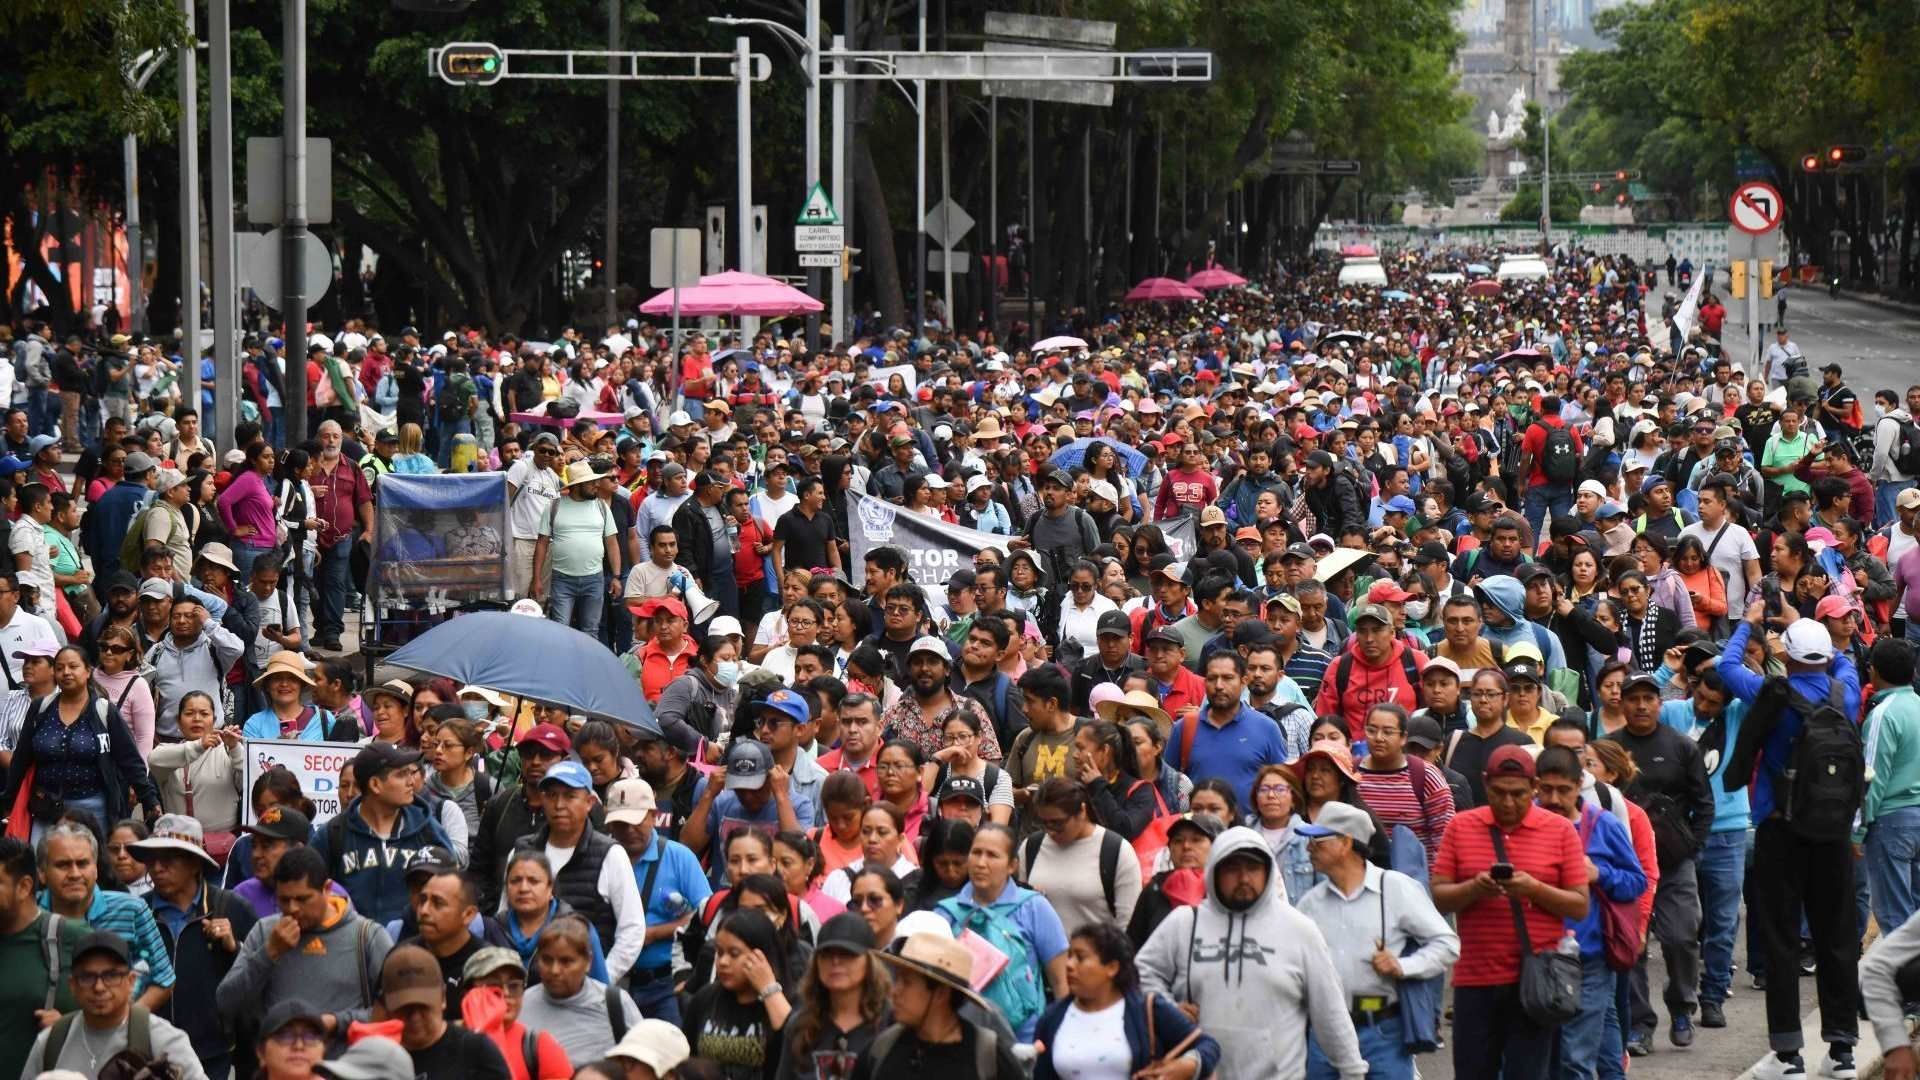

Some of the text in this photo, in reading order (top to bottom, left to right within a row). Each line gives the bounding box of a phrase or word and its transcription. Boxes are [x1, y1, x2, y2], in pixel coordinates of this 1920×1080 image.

[1172, 481, 1204, 502] 23
[910, 548, 960, 567] TOR
[908, 568, 952, 584] CHA
[1357, 687, 1399, 704] CR7
[1033, 744, 1069, 780] M
[314, 777, 340, 792] D-
[342, 847, 417, 875] NAVY
